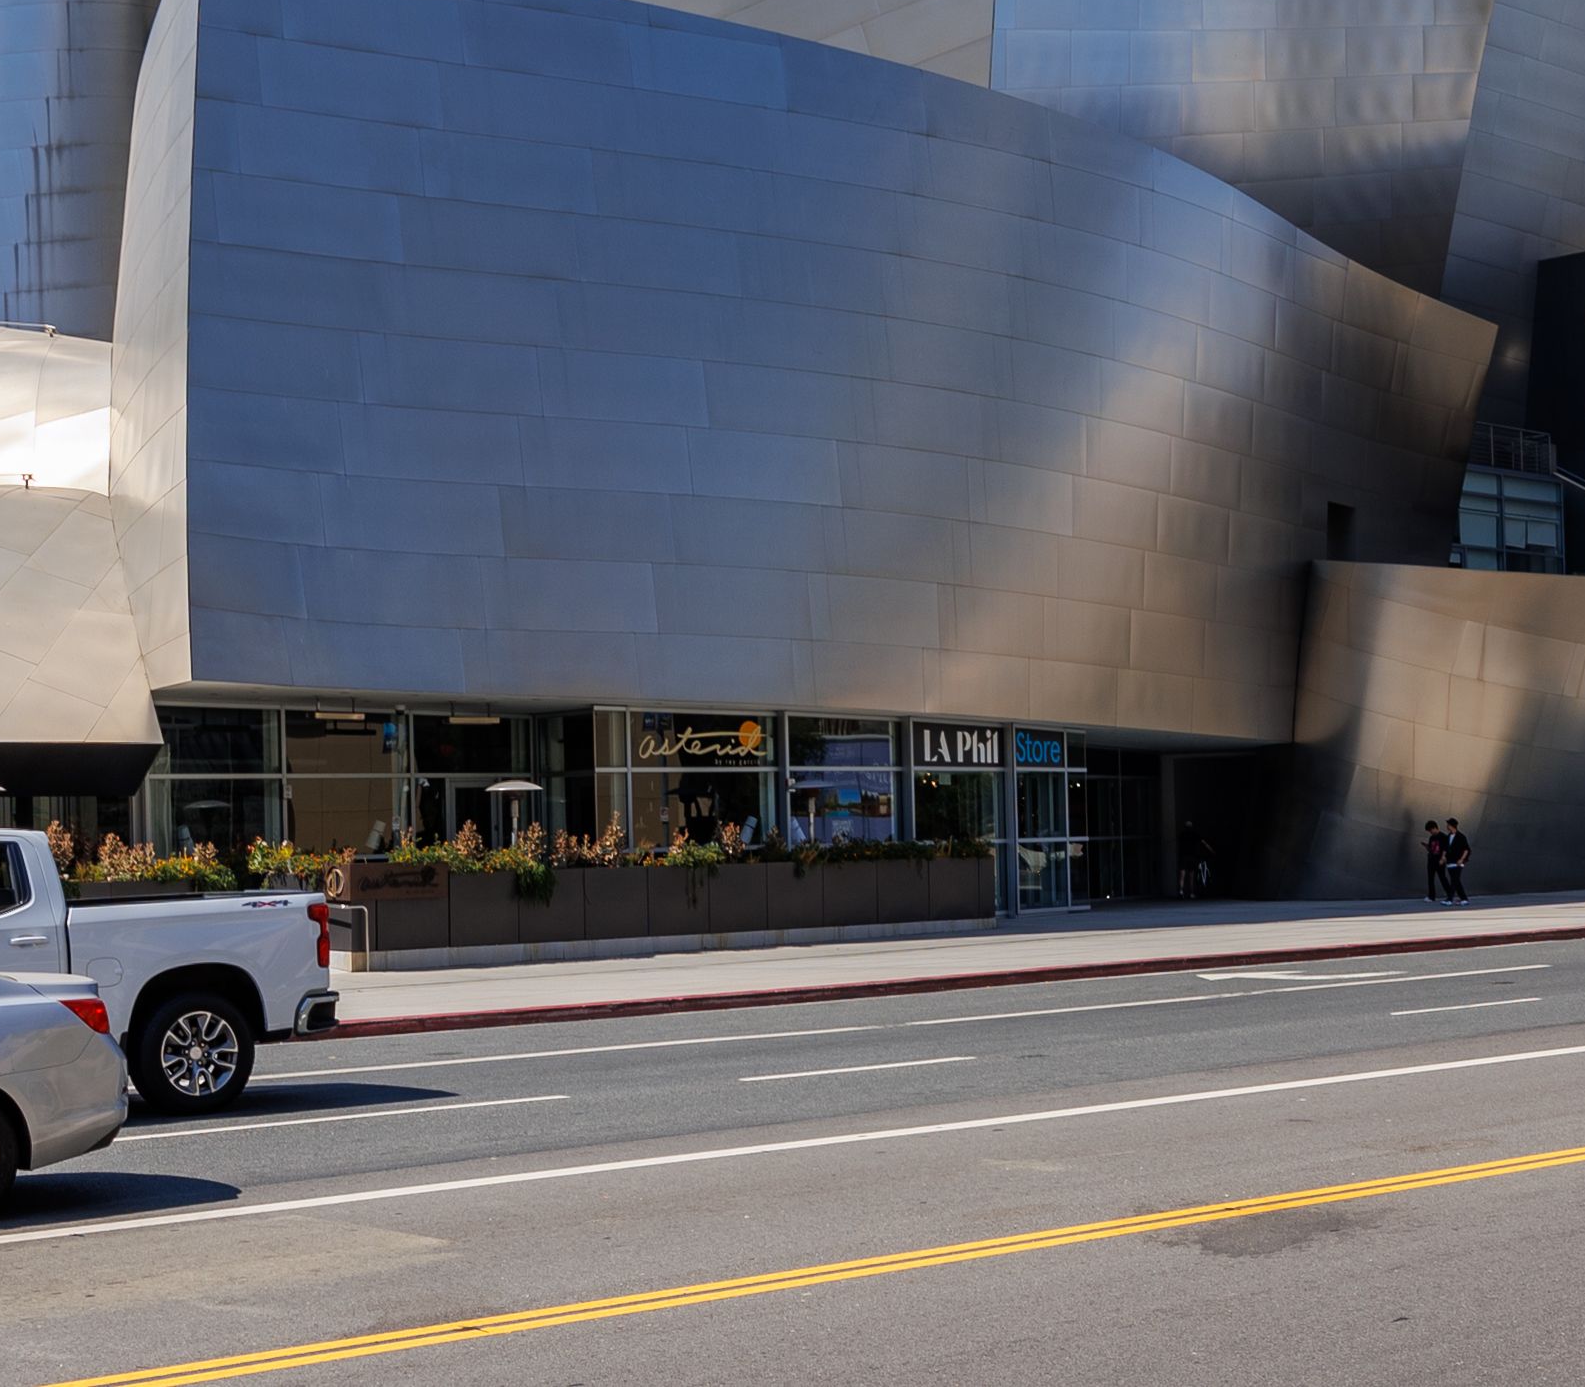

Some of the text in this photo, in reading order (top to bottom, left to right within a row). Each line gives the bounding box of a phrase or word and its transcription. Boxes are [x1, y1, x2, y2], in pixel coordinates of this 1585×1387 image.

[638, 726, 767, 759] asterid
[923, 729, 1061, 764] LA Phil Store
